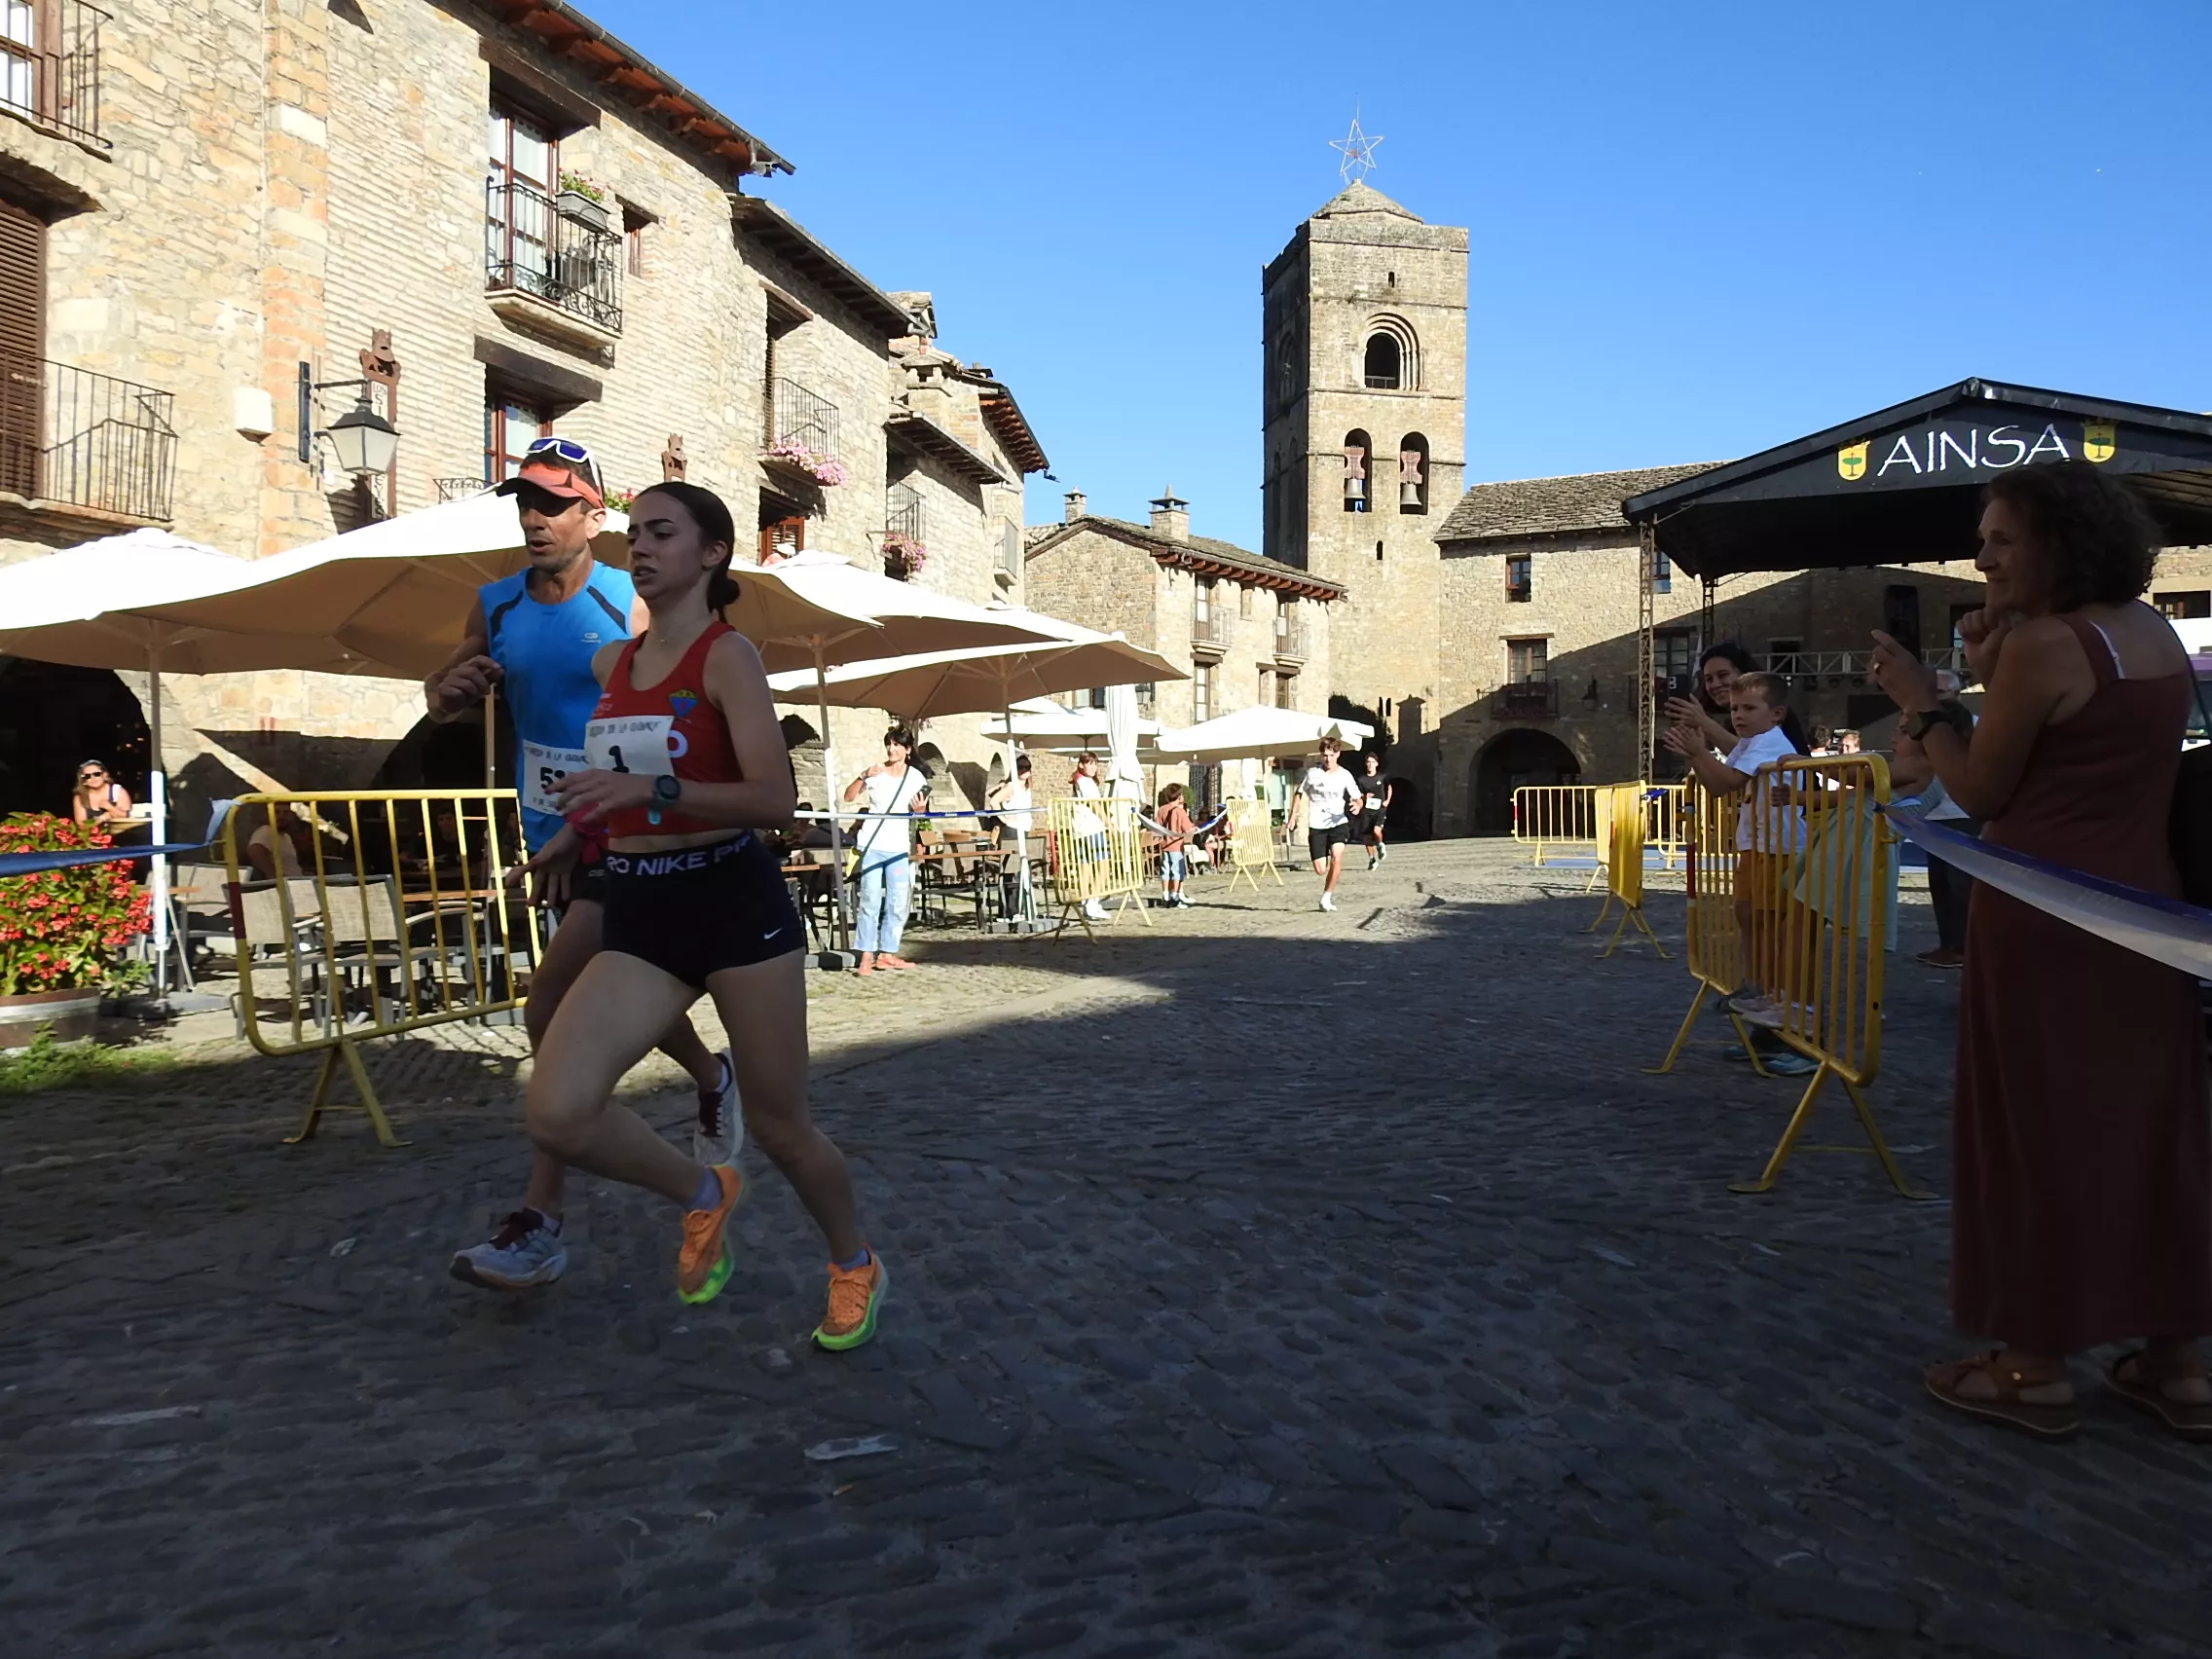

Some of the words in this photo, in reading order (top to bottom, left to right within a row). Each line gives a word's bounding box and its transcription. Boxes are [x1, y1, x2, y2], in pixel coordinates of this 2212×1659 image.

[1876, 423, 2071, 477] AINSA
[608, 745, 630, 774] 1
[636, 850, 708, 876] NIKE
